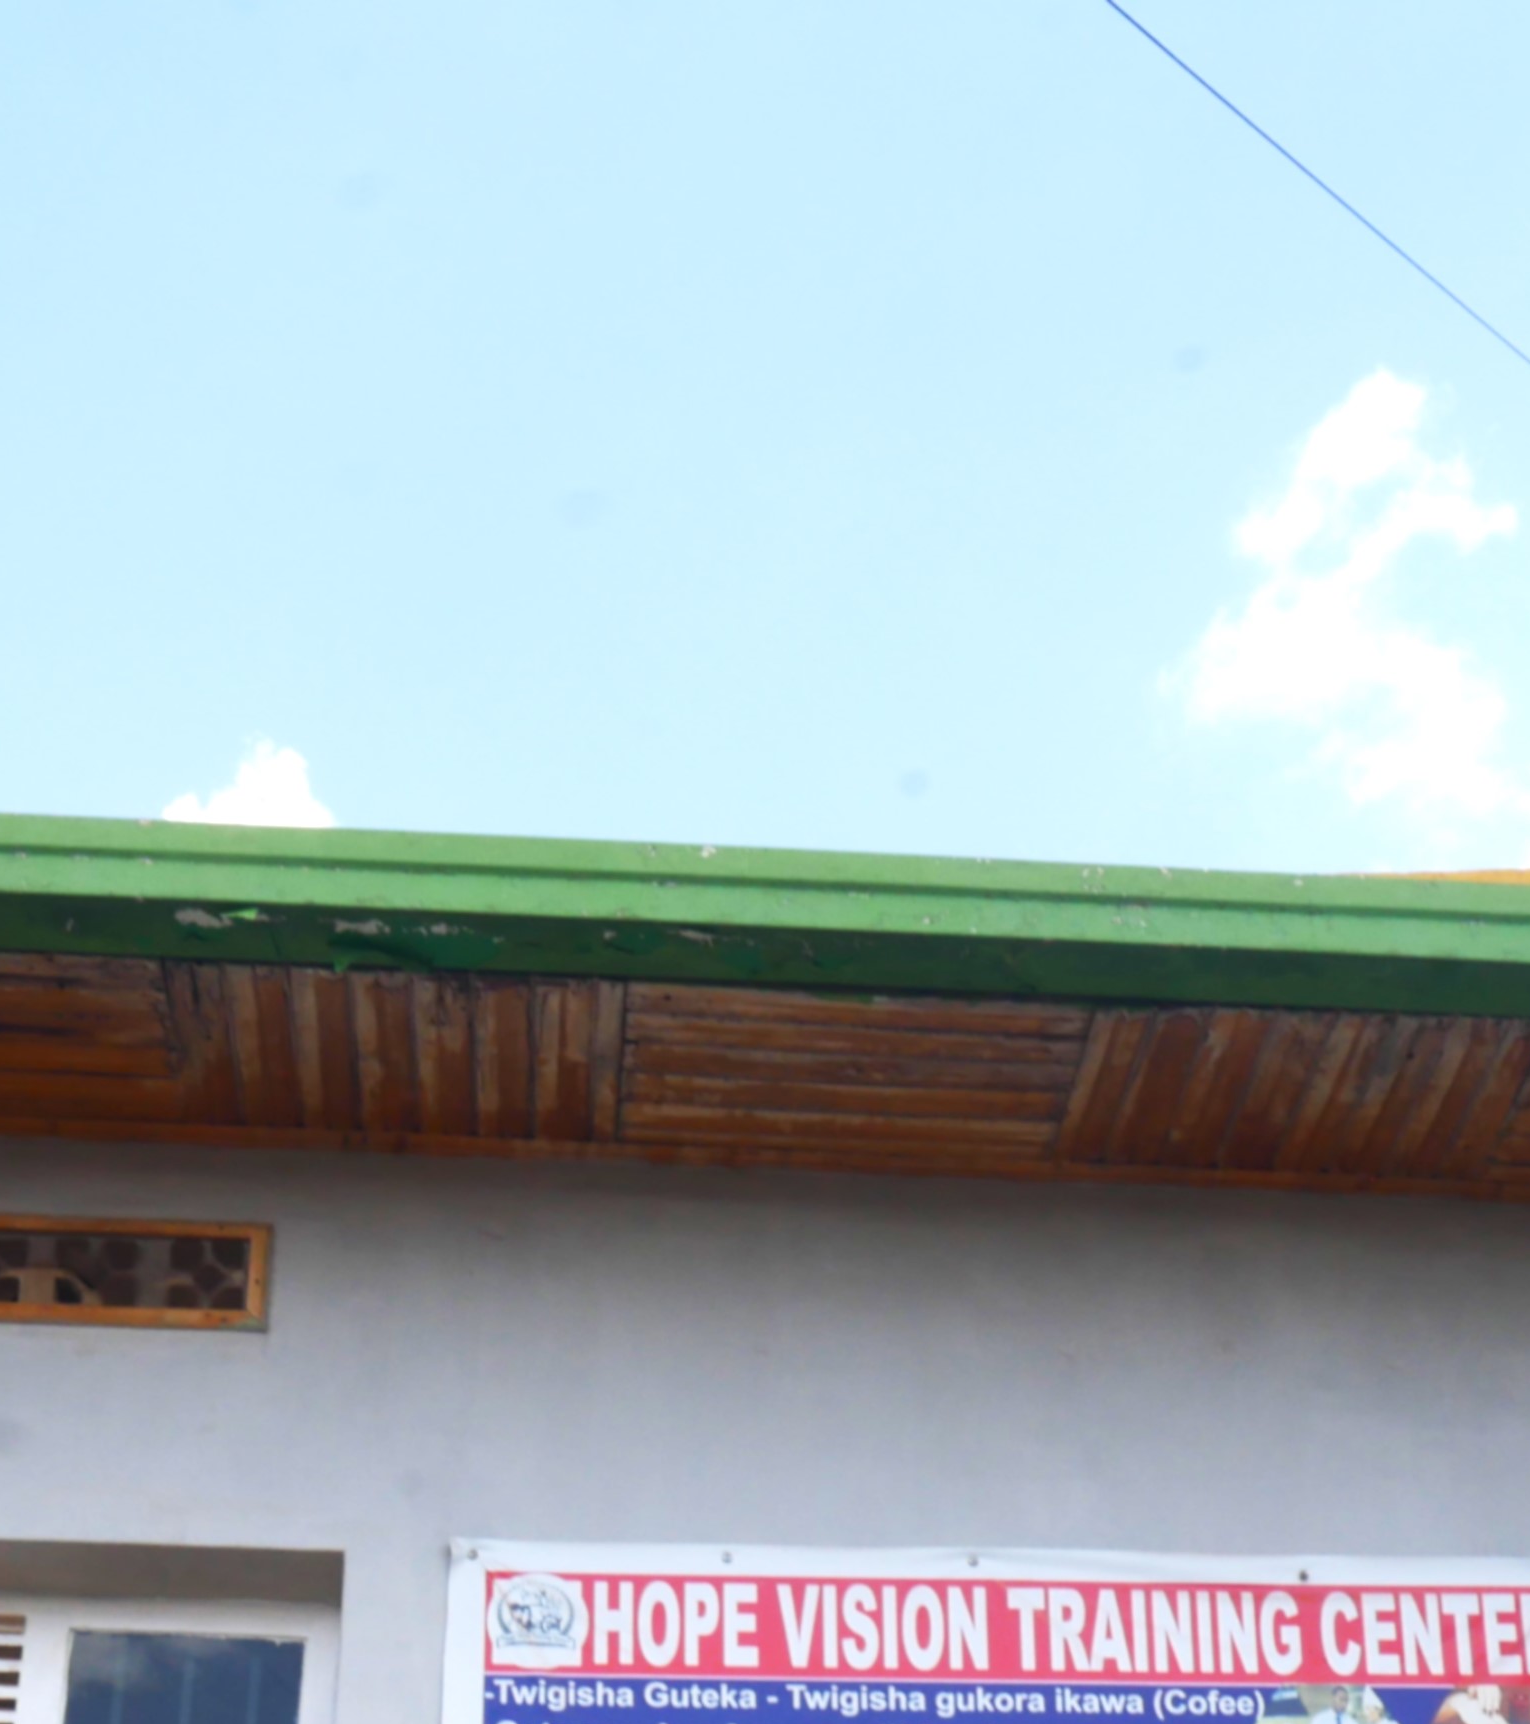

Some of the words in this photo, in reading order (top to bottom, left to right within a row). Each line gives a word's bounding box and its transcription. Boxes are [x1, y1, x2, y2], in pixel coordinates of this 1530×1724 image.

[593, 1580, 760, 1668] HOPE
[776, 1583, 989, 1671] VISION
[1006, 1587, 1303, 1676] TRAINING
[485, 1679, 634, 1712] -Twigisha
[643, 1681, 757, 1709] Guteka
[786, 1683, 926, 1716] Twigisha
[935, 1686, 1046, 1718] gukora
[1055, 1687, 1144, 1715] ikawa
[1153, 1688, 1266, 1721] (Cofee)
